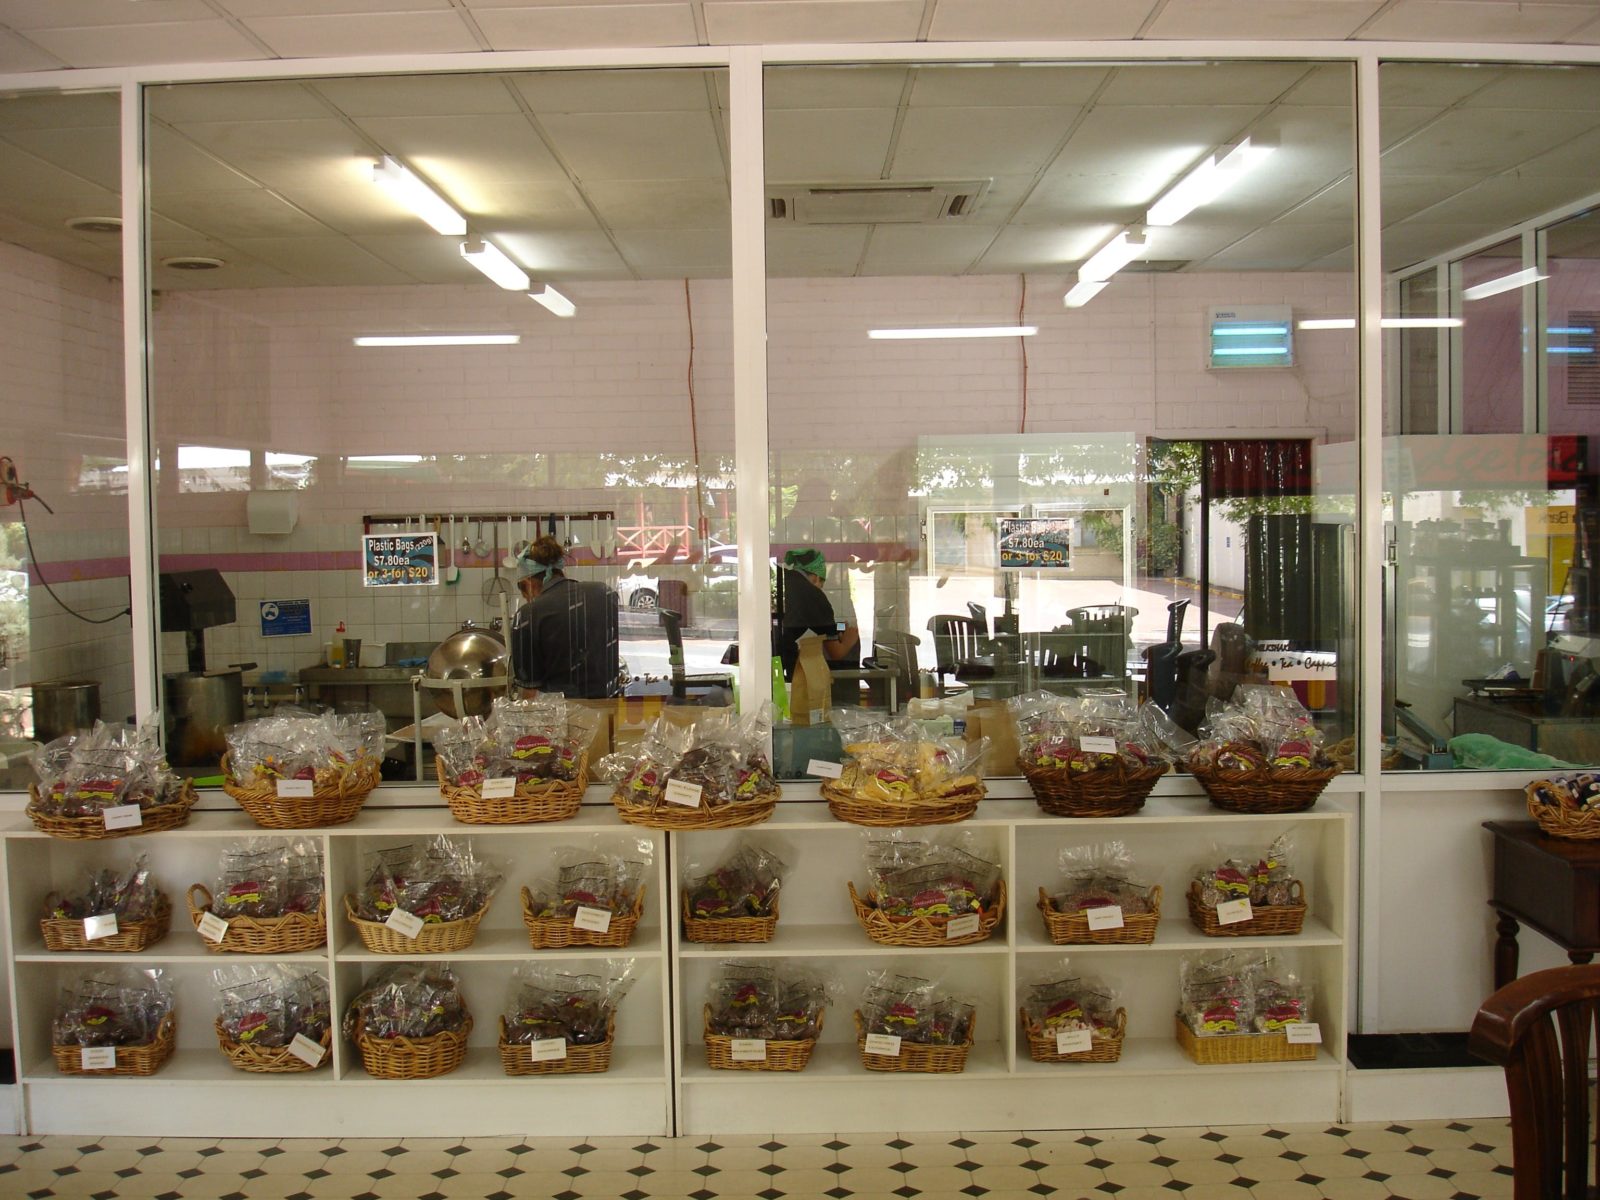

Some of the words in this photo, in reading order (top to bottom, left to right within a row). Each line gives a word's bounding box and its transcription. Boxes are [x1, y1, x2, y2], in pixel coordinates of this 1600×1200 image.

[368, 540, 394, 552] Plastic
[395, 538, 414, 553] Bags
[1008, 538, 1045, 548] $7.80ea
[374, 555, 410, 566] $7.80ea
[1043, 550, 1062, 561] $20
[367, 570, 379, 579] or
[408, 567, 428, 577] $20
[643, 673, 660, 686] Tea
